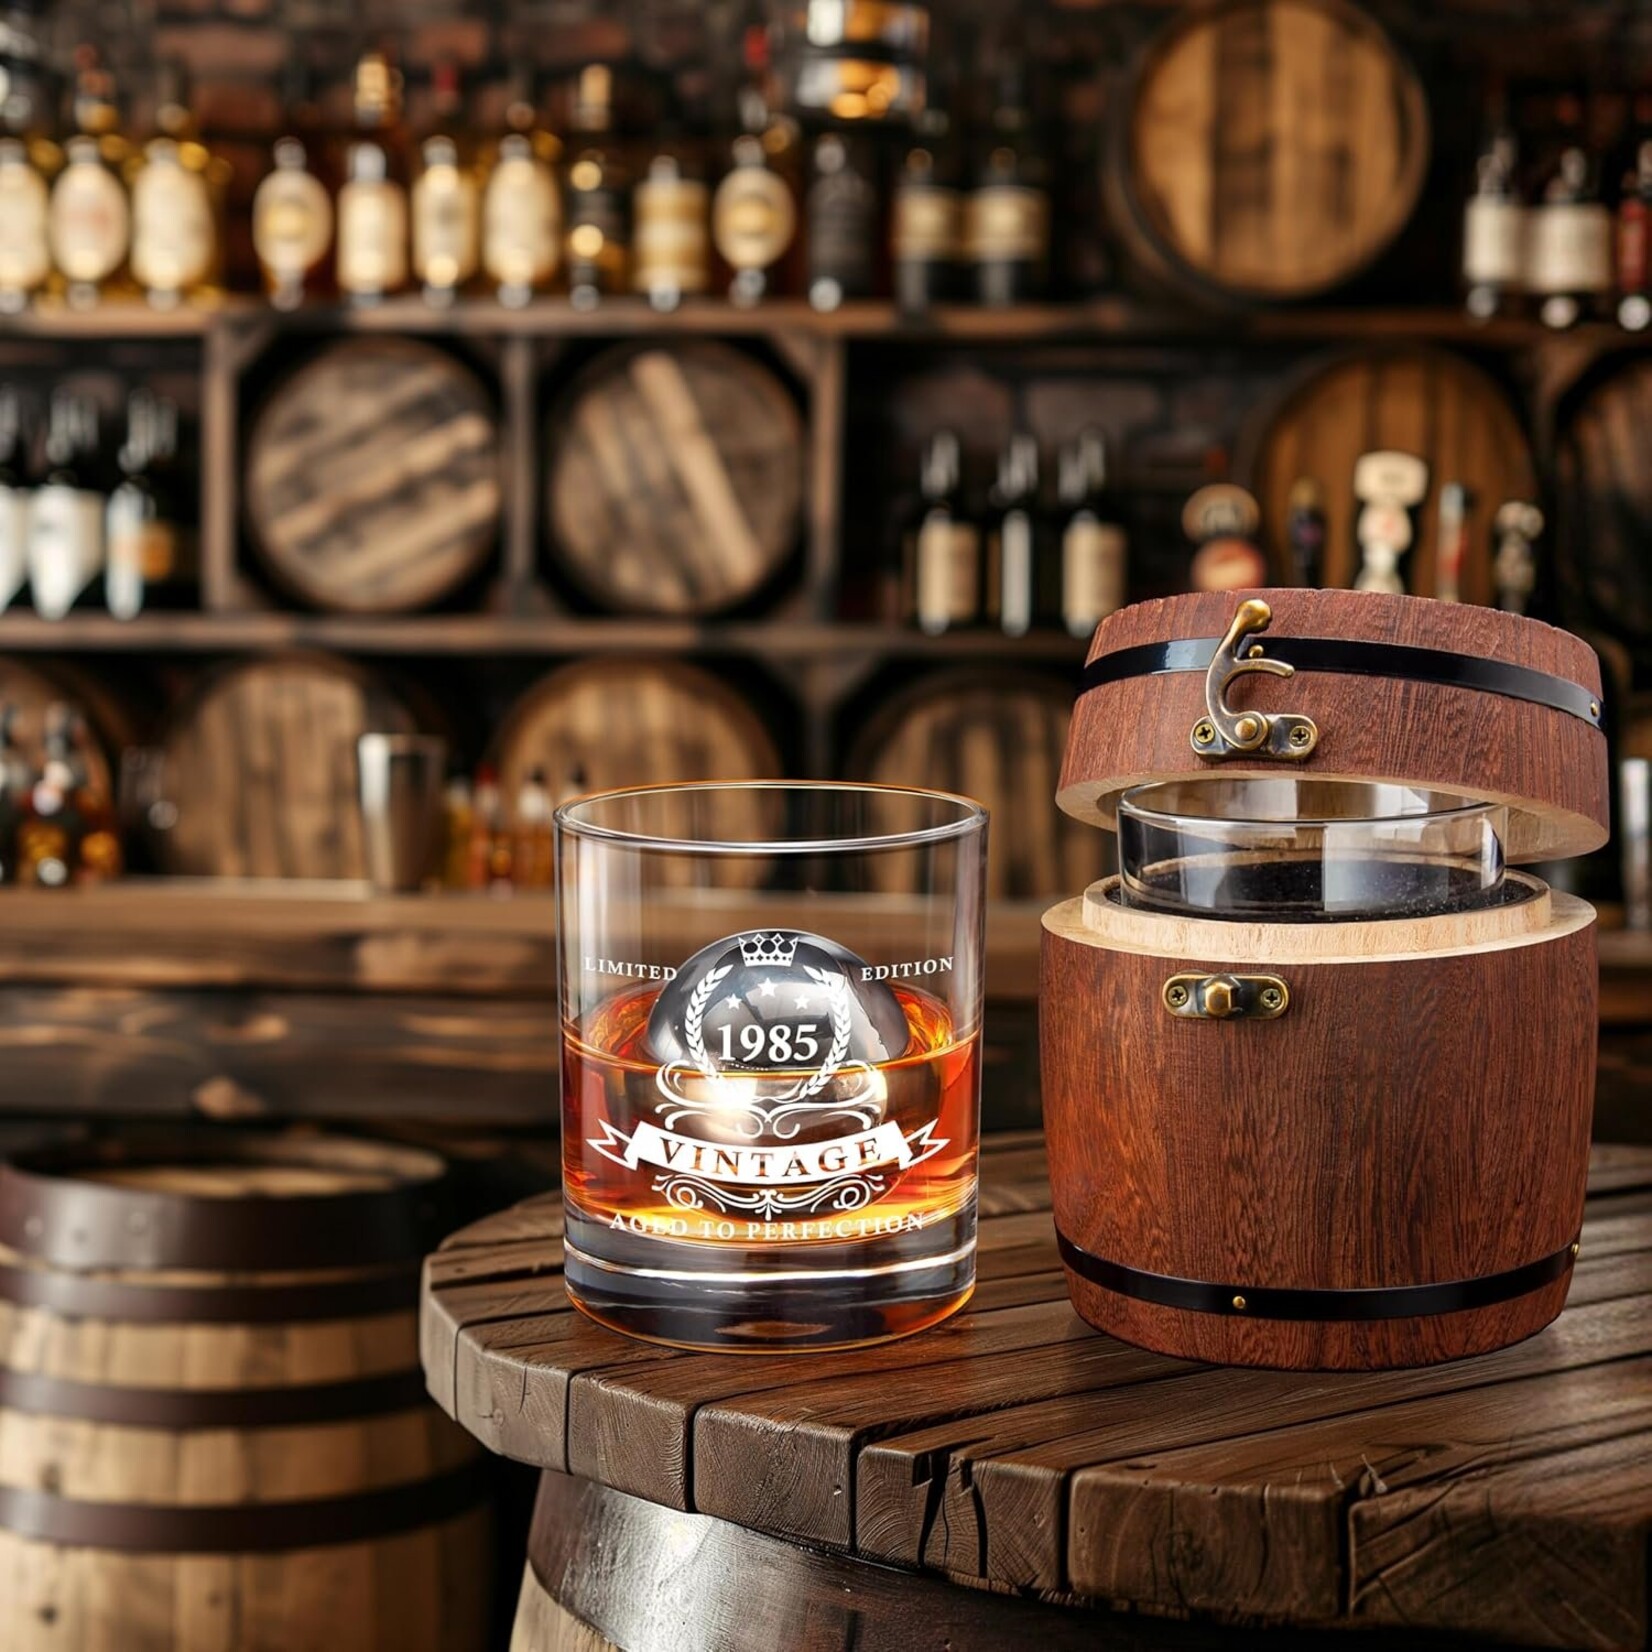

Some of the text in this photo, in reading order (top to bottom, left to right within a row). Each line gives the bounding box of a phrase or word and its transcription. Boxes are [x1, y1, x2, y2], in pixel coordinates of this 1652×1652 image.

[584, 956, 954, 982] LIMITED EDITION
[717, 1023, 819, 1063] 1985
[659, 1136, 882, 1178] VINTAGE
[609, 1212, 925, 1241] AGED TO PERFECTION
